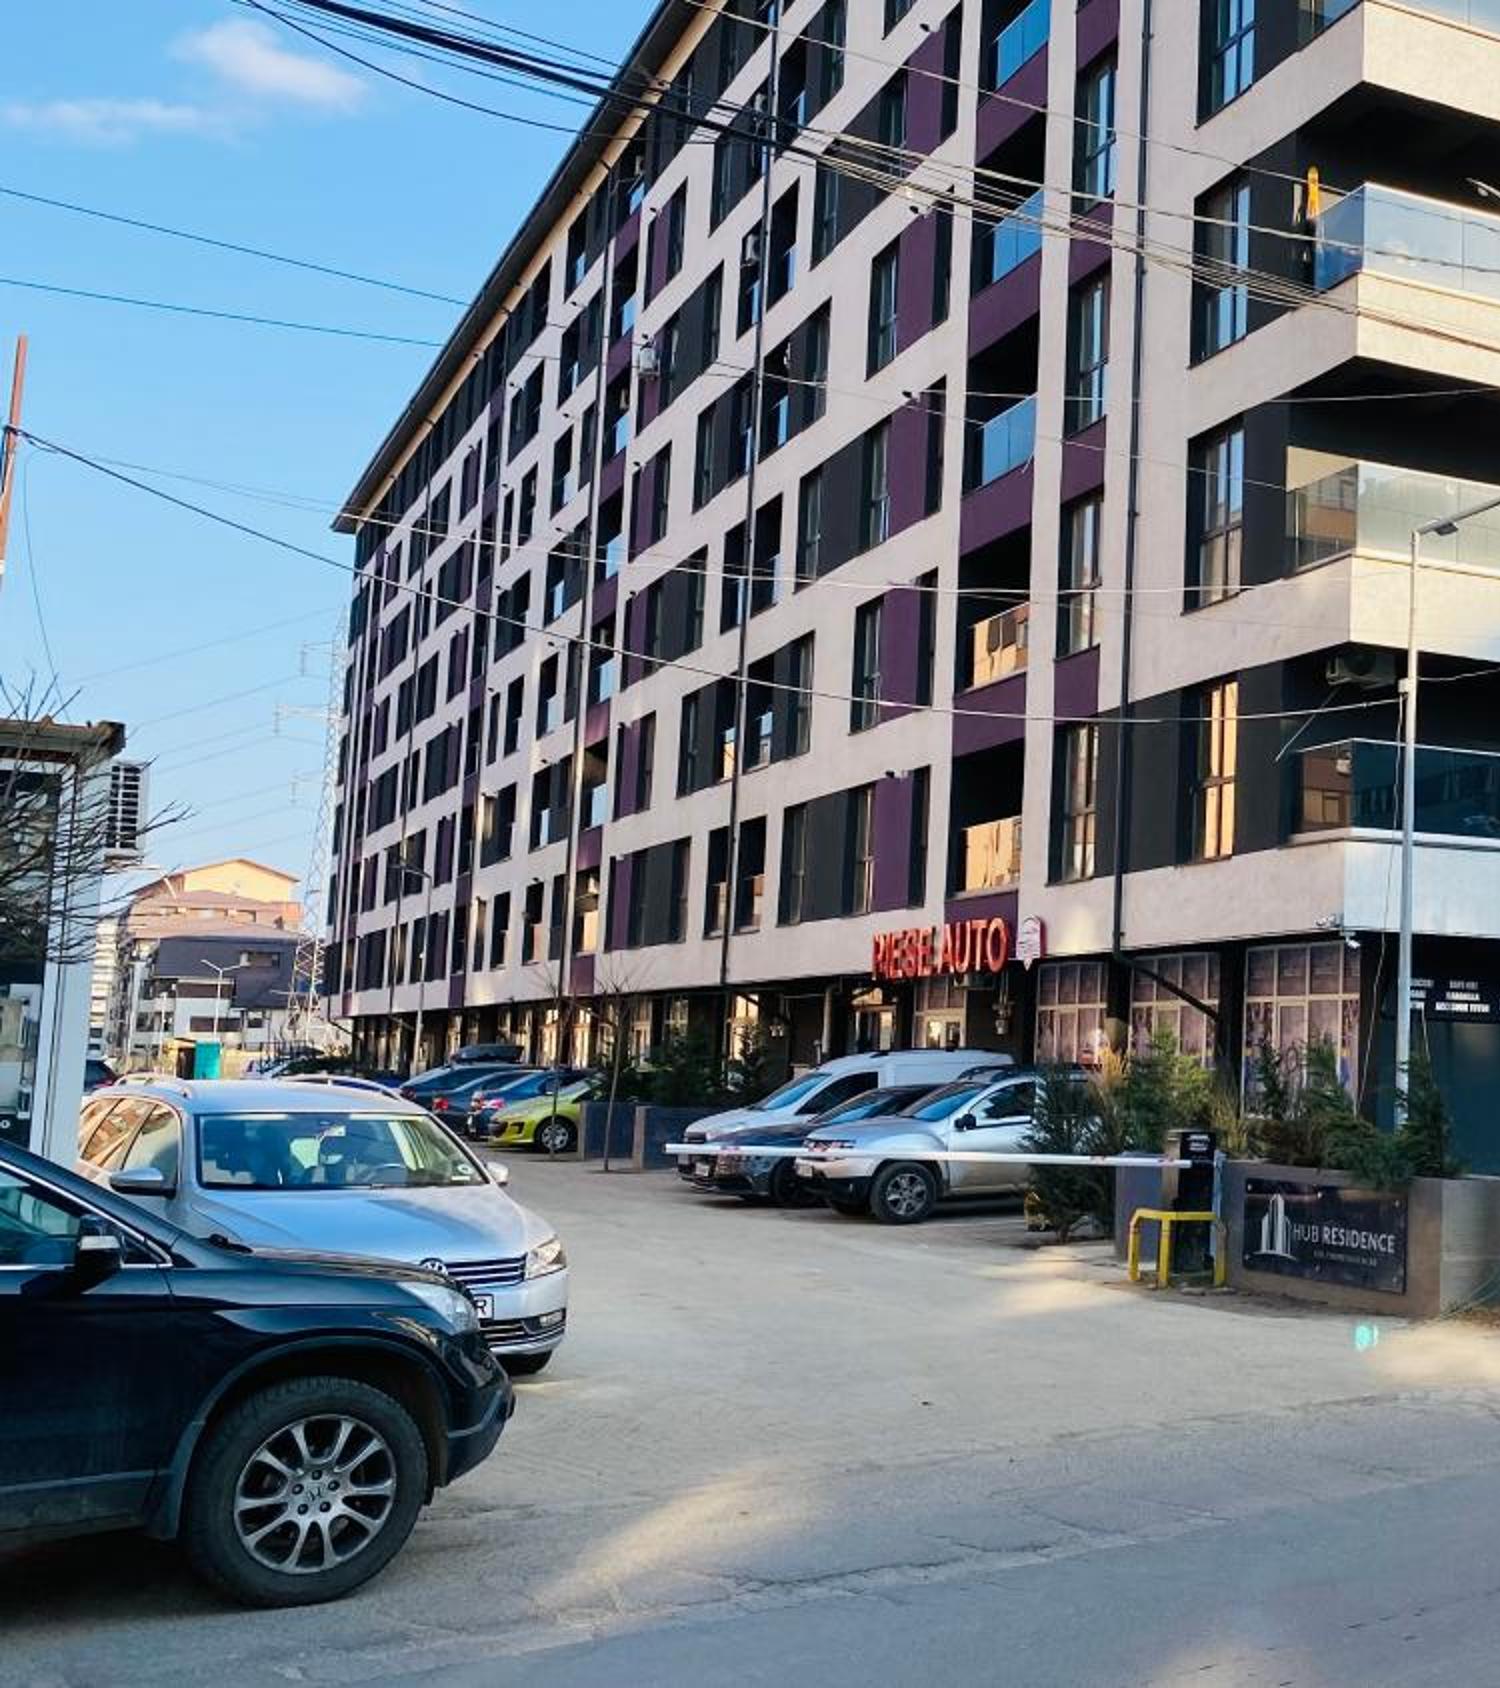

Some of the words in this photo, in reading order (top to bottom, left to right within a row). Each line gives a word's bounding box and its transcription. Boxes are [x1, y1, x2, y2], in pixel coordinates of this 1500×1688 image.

[937, 916, 1008, 974] AUTO
[1294, 1223, 1319, 1243] HUB
[1321, 1226, 1396, 1254] RESIDENCE
